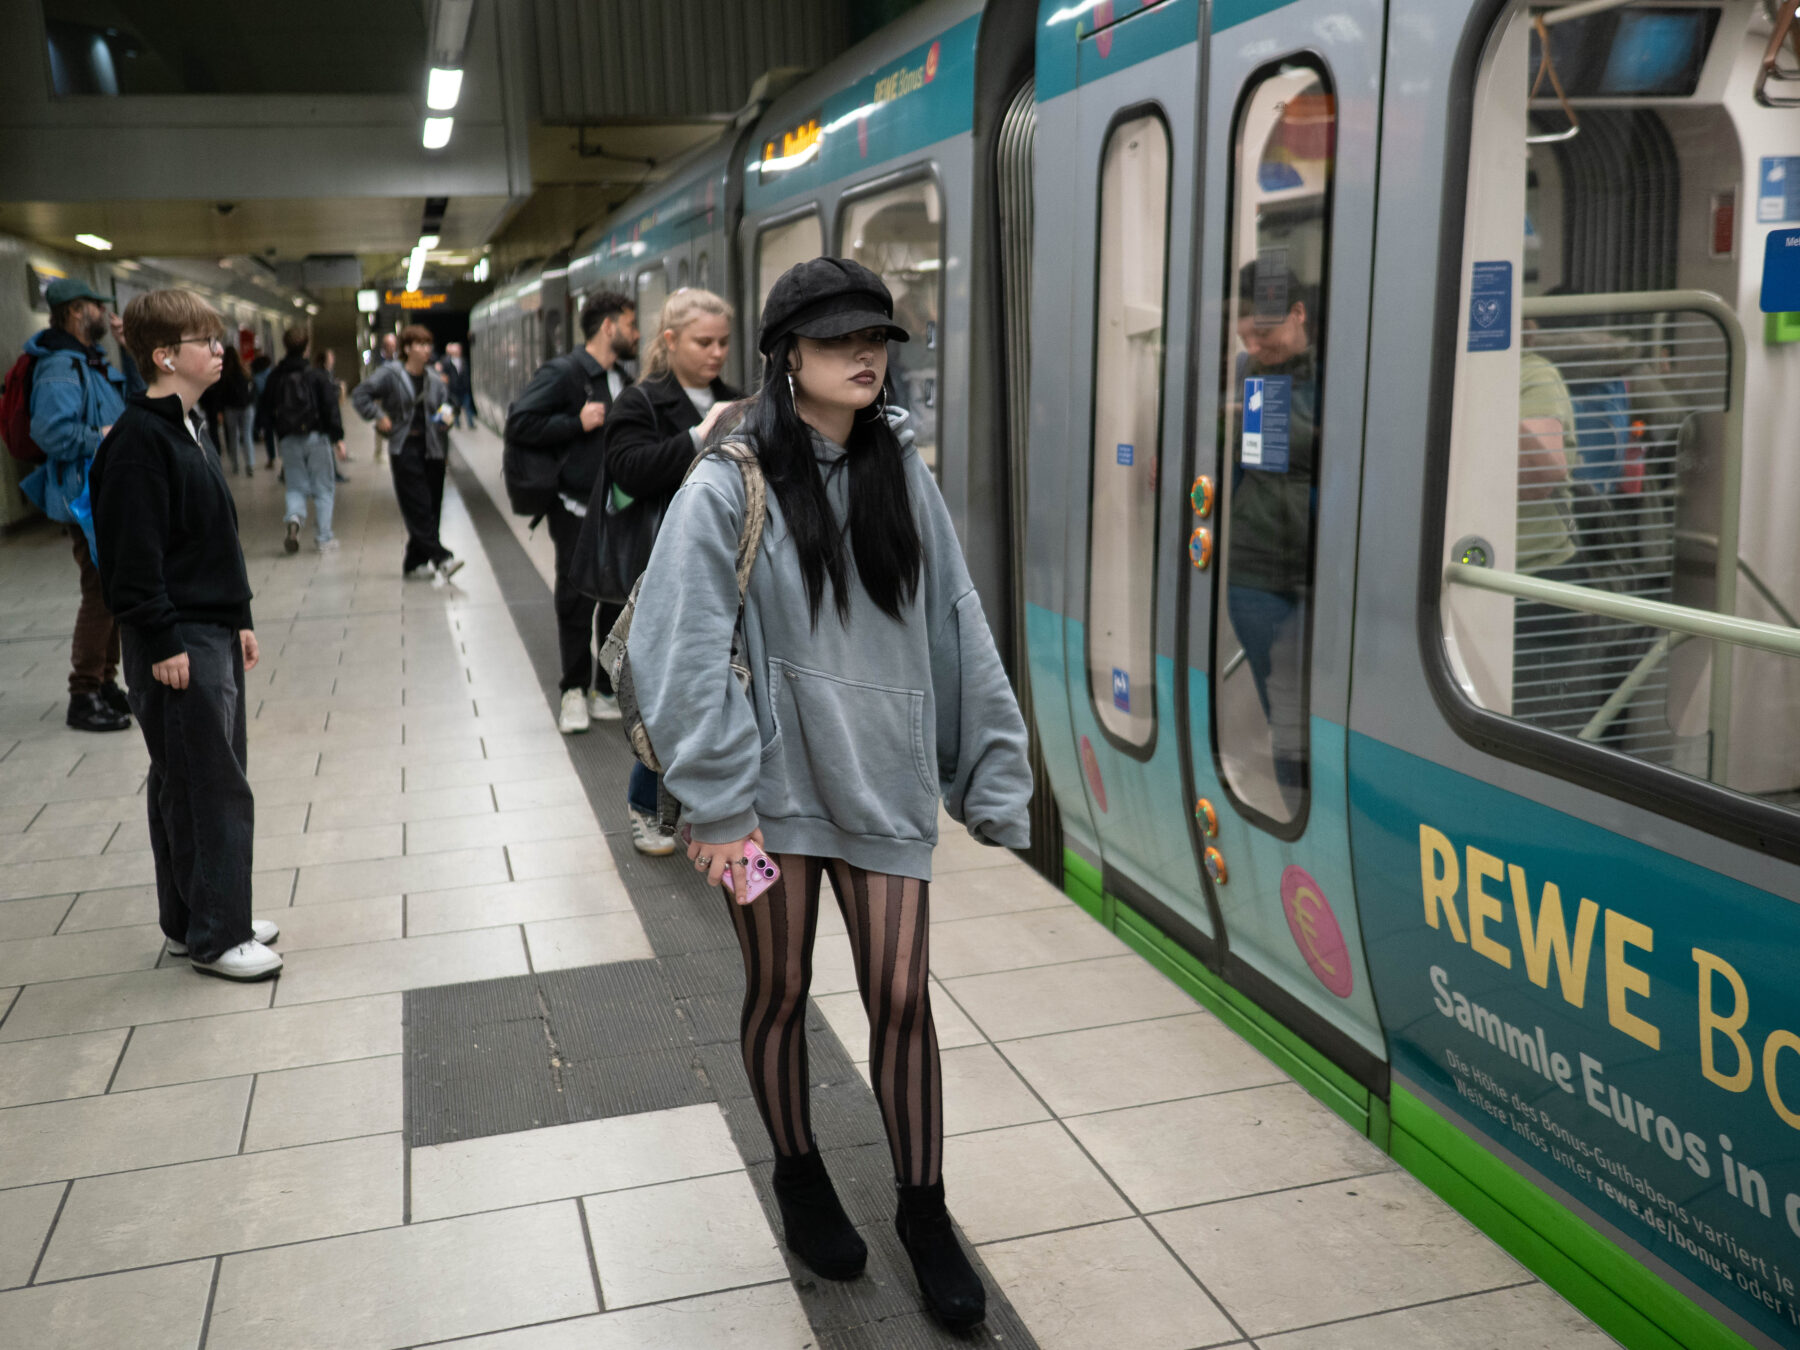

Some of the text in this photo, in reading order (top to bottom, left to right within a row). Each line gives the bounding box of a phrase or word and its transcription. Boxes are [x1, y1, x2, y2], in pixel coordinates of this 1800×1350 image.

[1785, 236, 1800, 247] Me
[1419, 823, 1660, 1051] REWE
[1430, 965, 1771, 1218] Sammle Euros in
[1445, 1049, 1470, 1077] Die
[1471, 1065, 1509, 1103] Höhe
[1512, 1093, 1538, 1122] des
[1539, 1111, 1689, 1224] Bonus-Guthabens
[1692, 1215, 1769, 1280] variiert
[1773, 1265, 1795, 1297] je
[1453, 1074, 1800, 1328] Weitere Infos unter rewe.de/bonus oder i
